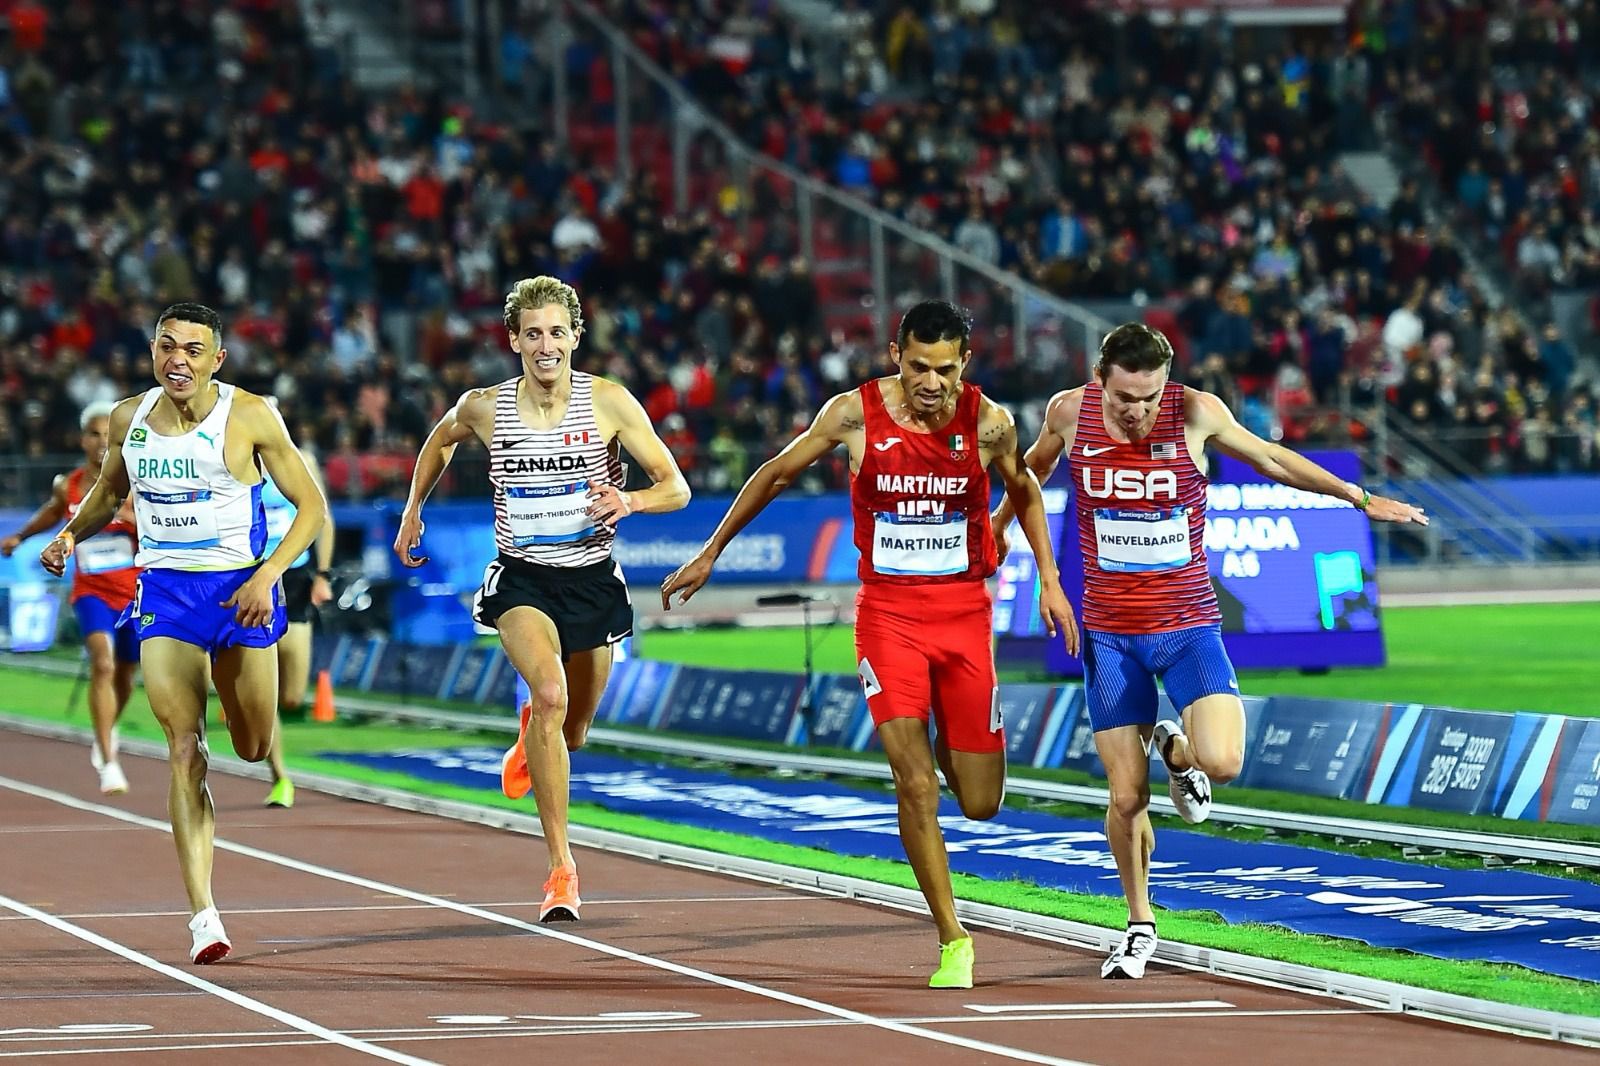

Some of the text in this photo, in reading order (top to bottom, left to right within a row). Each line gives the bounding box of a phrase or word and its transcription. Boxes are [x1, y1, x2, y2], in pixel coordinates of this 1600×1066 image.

[138, 458, 200, 479] BRASIL
[503, 455, 588, 473] CANADA
[876, 472, 969, 495] MARTÍNEZ
[1082, 466, 1177, 500] USA
[151, 514, 199, 528] DA SILVA
[880, 535, 961, 551] MARTINEZ
[1100, 532, 1185, 547] KNEVELBAARD
